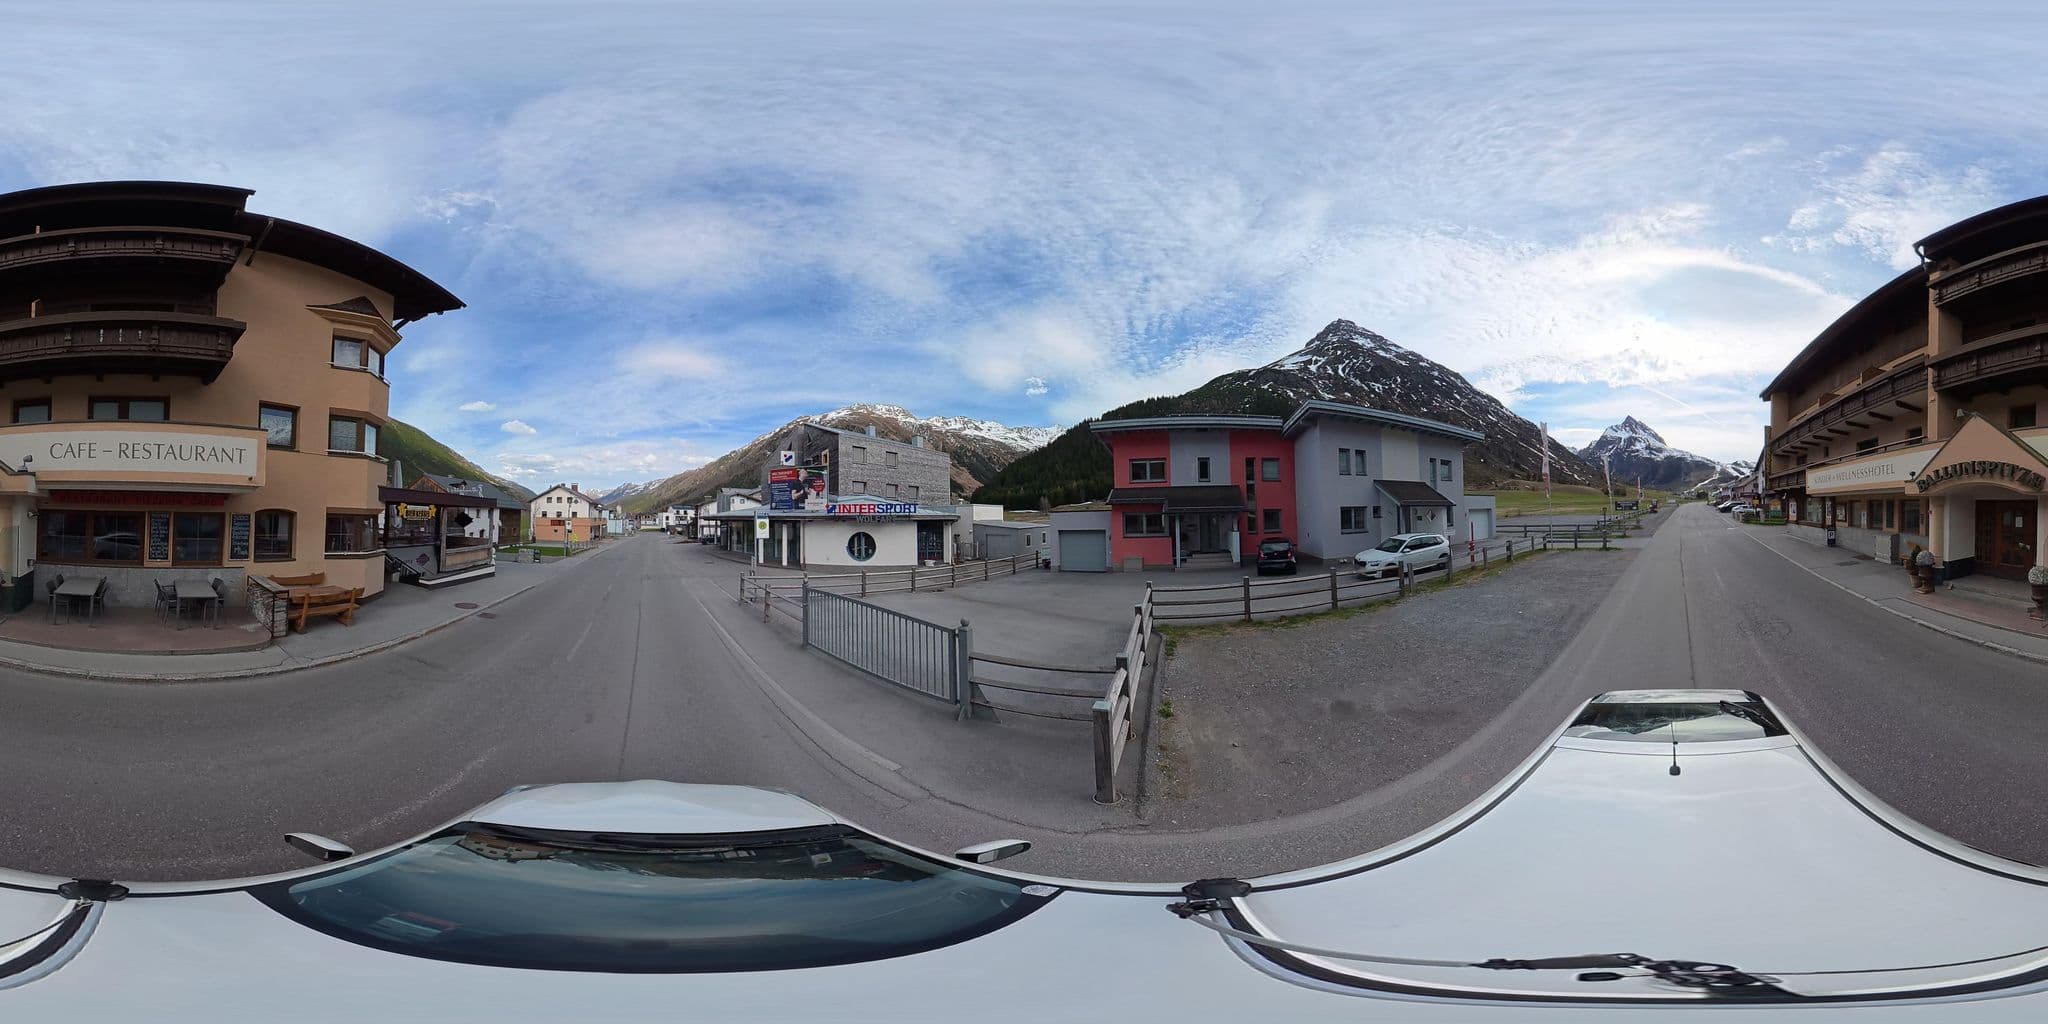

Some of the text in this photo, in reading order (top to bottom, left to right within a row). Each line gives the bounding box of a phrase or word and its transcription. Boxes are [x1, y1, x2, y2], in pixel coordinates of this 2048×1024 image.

[49, 442, 97, 459] CAFE
[118, 442, 247, 464] RESTAURANT
[838, 503, 919, 514] INTERSPORT
